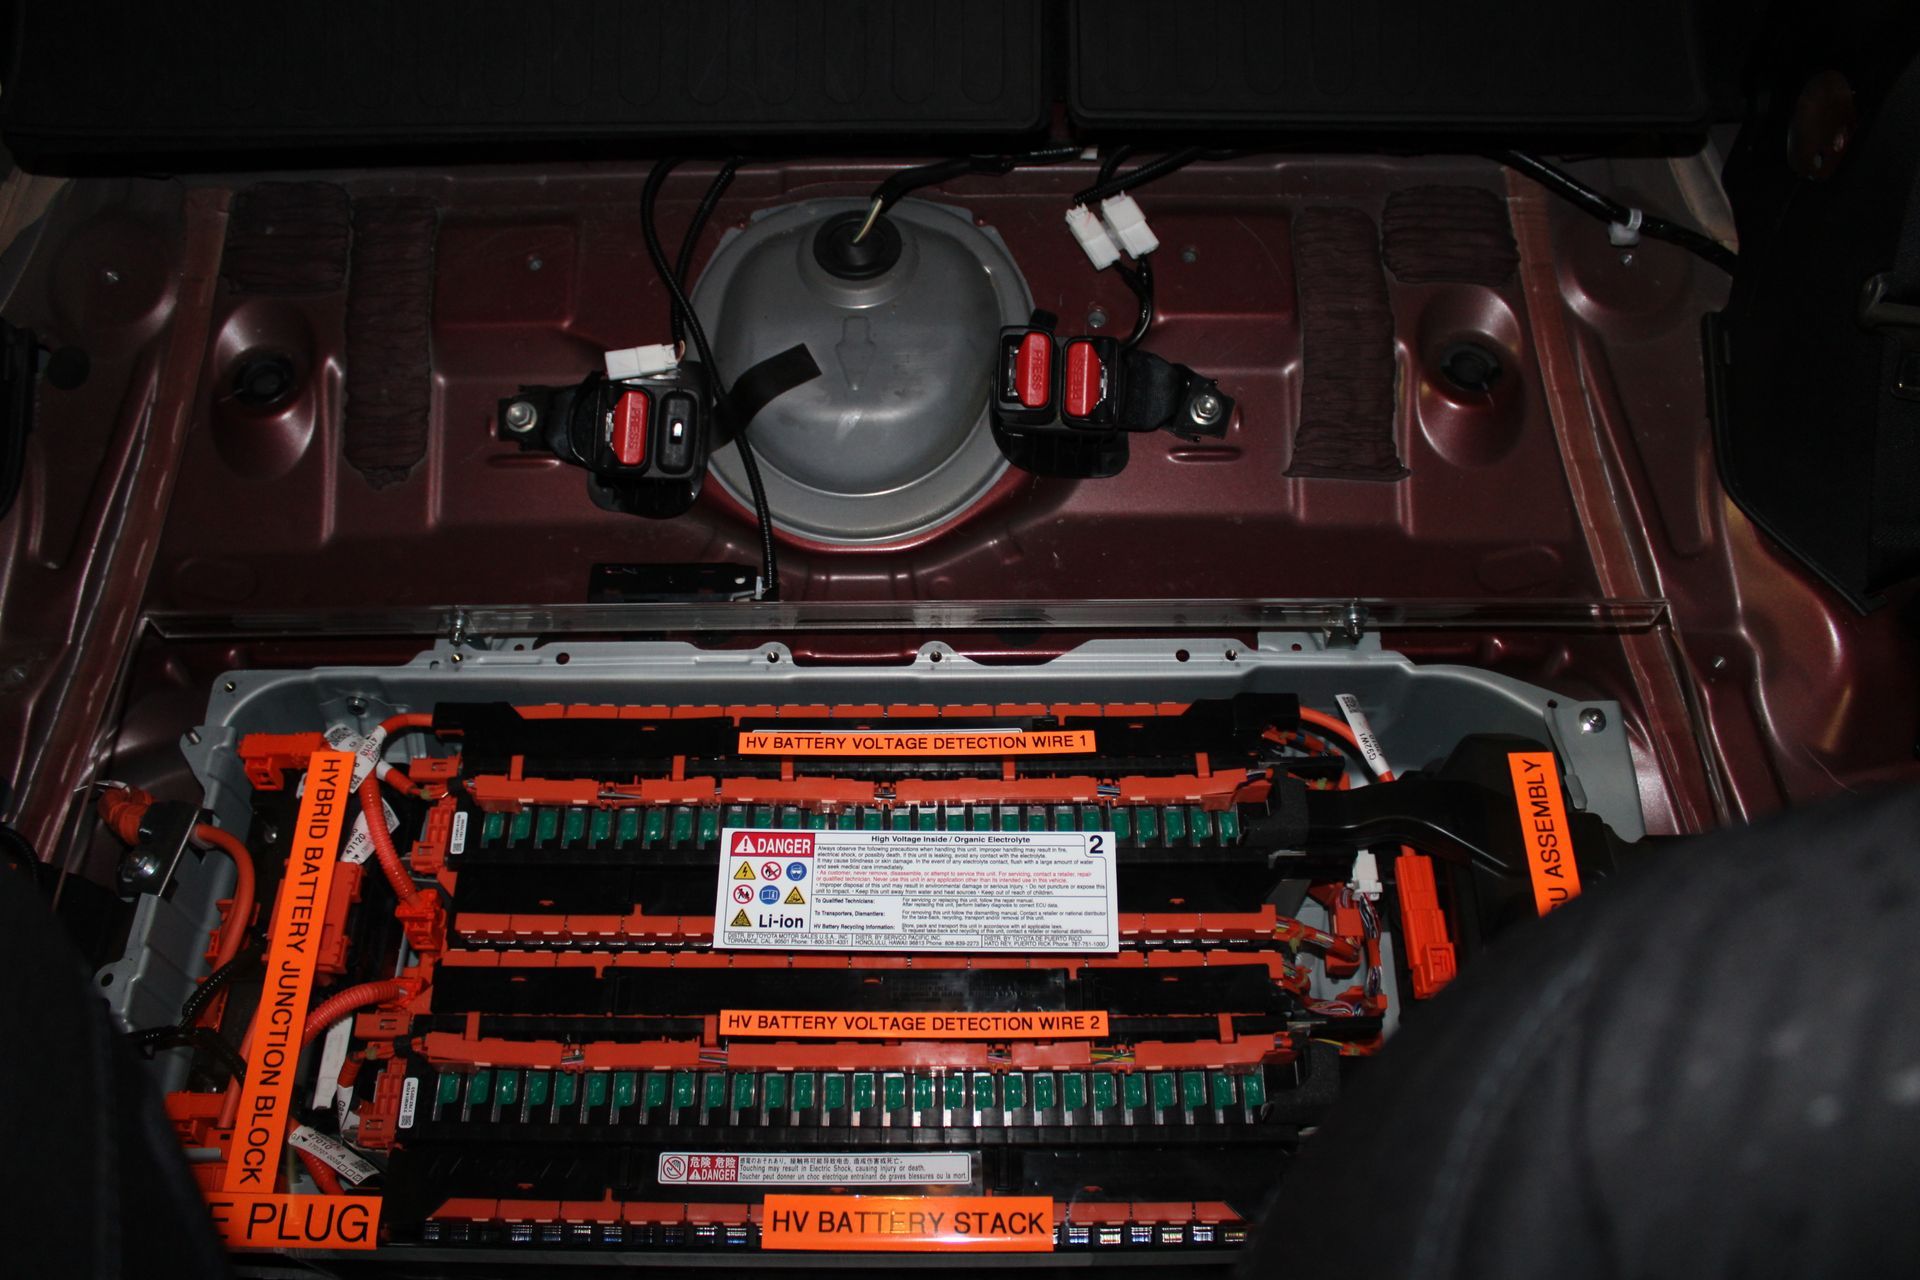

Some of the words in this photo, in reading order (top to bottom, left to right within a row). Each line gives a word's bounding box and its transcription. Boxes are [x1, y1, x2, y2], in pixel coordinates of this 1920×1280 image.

[1032, 349, 1042, 391] PRESS
[746, 736, 769, 749] HV
[773, 736, 847, 750] BATTERY
[852, 737, 928, 750] VOLTAGE
[933, 736, 1027, 750] DETECTION
[1031, 734, 1074, 748] WIRE
[1079, 734, 1086, 747] 1
[308, 758, 342, 839] HYBRID
[1522, 758, 1564, 880] ASSEMBLY
[346, 833, 367, 855] 47120
[757, 838, 811, 854] DANGER
[872, 836, 890, 844] High
[1089, 834, 1104, 854] 2
[286, 846, 324, 954] BATTERY
[758, 914, 804, 928] Li-ion
[258, 960, 301, 1087] JUNCTION
[728, 1015, 752, 1029] HV
[757, 1015, 838, 1030] BATTERY
[843, 1016, 926, 1031] VOLTAGE
[932, 1016, 1033, 1032] DETECTION
[1038, 1015, 1085, 1031] WIRE
[1090, 1015, 1100, 1029] 2
[239, 1095, 277, 1185] BLOCK
[307, 1133, 333, 1150] 47010
[701, 1170, 736, 1182] DANGER
[246, 1202, 370, 1243] PLUG
[771, 1210, 810, 1233] HV
[817, 1210, 946, 1234] BATTERY
[954, 1211, 1046, 1235] STACK
